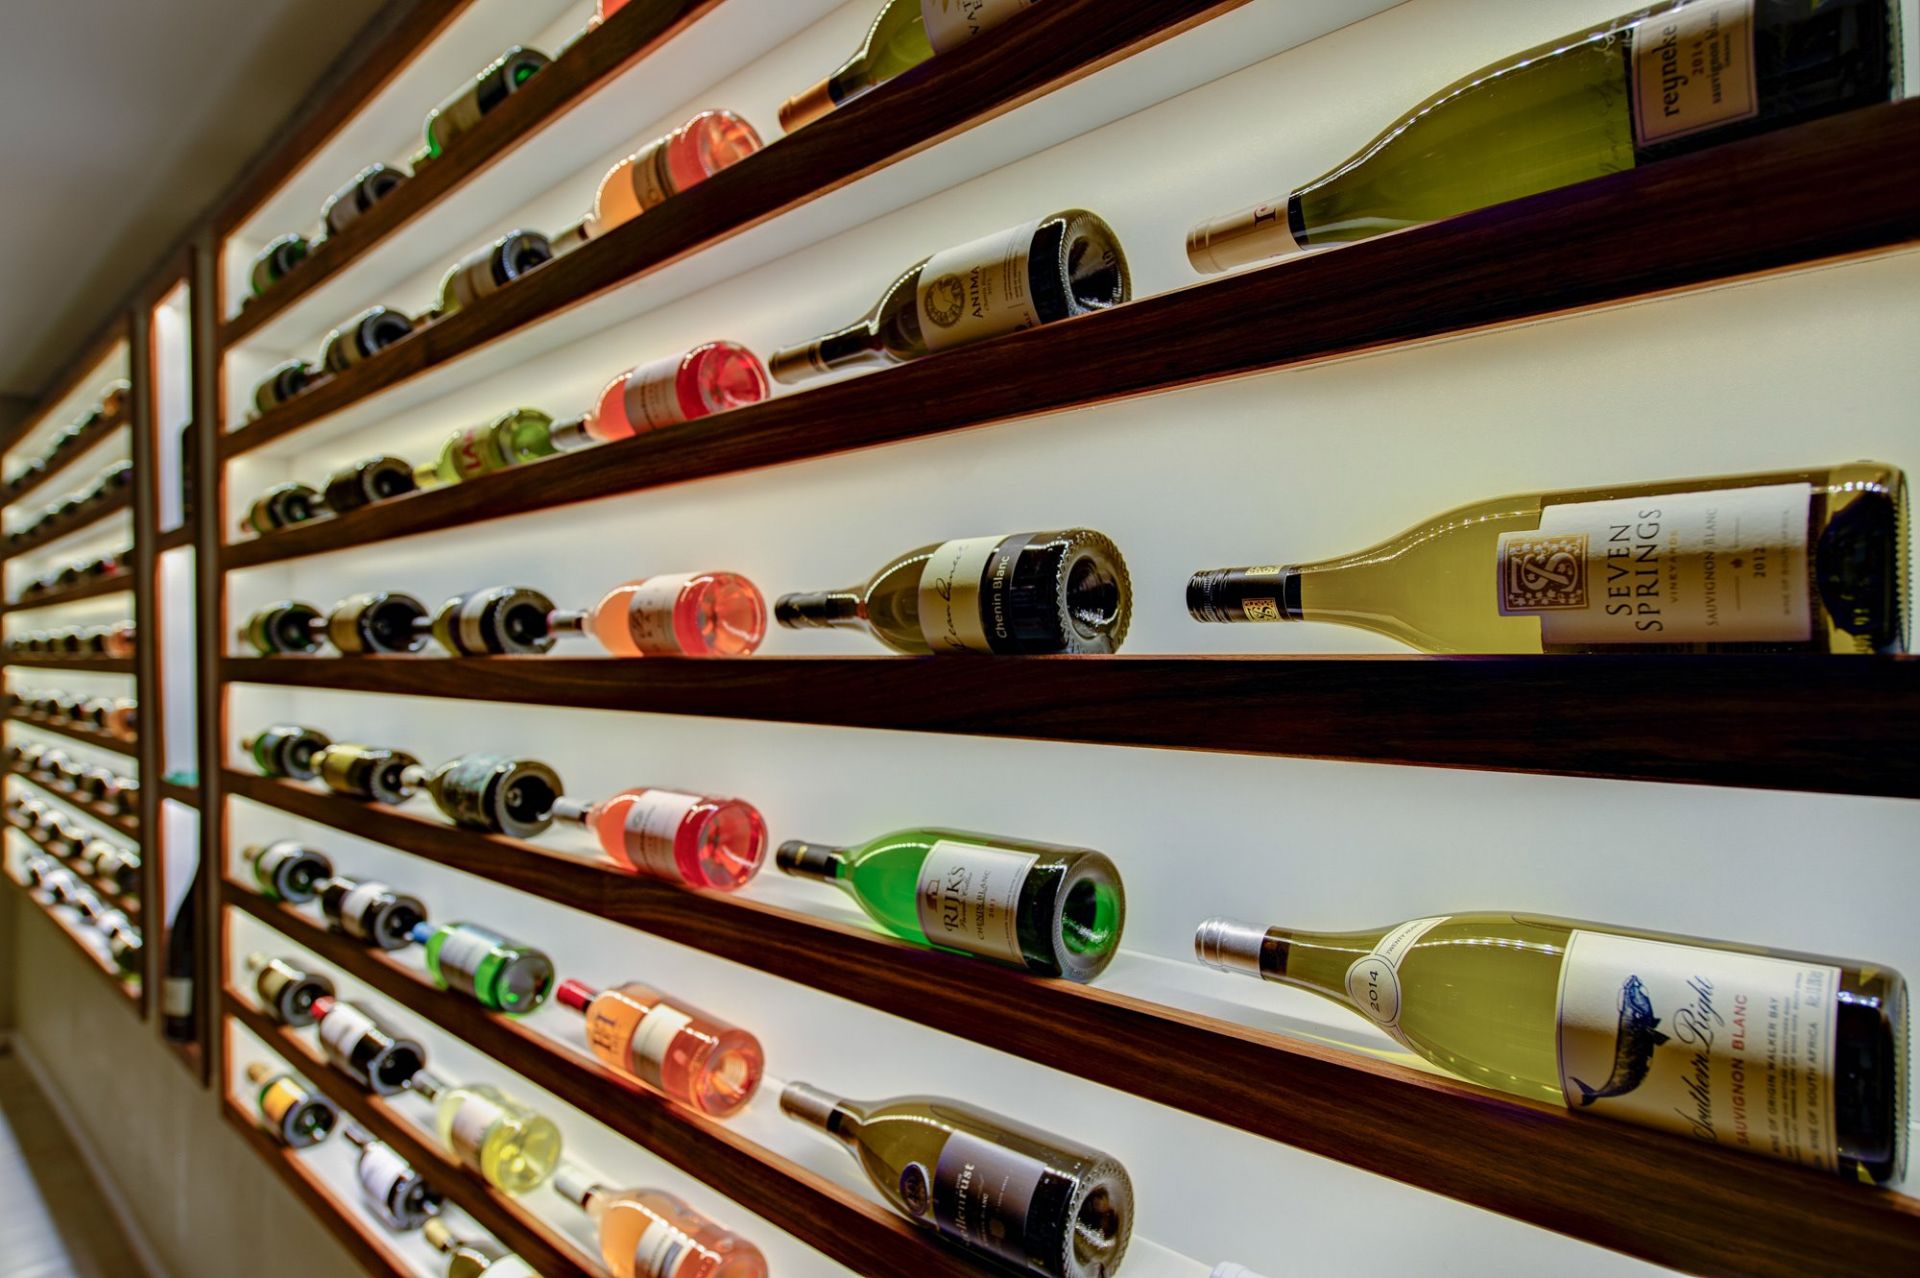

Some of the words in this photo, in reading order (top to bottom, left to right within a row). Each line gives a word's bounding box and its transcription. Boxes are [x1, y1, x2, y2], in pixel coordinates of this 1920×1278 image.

[1652, 24, 1688, 118] reyneke
[970, 265, 984, 319] ANIMA
[1705, 508, 1718, 547] BLANC
[992, 555, 1010, 590] Blanc
[1605, 524, 1632, 616] SEVEN
[1635, 508, 1663, 632] SPRINGS
[1704, 551, 1718, 627] SAUVIGNON
[992, 592, 1008, 639] Chenin
[1368, 970, 1380, 1013] 2014
[1673, 975, 1725, 1053] Right
[1769, 996, 1779, 1019] BAY
[1731, 993, 1748, 1051] BLANC
[1767, 1022, 1778, 1071] WALKER
[1808, 1022, 1819, 1064] AFRICA
[1673, 1052, 1718, 1143] Southern
[1730, 1058, 1749, 1145] SAUVIGNON
[1767, 1073, 1778, 1115] ORIGIN
[1807, 1068, 1818, 1107] SOUTH
[1808, 1109, 1819, 1126] OF
